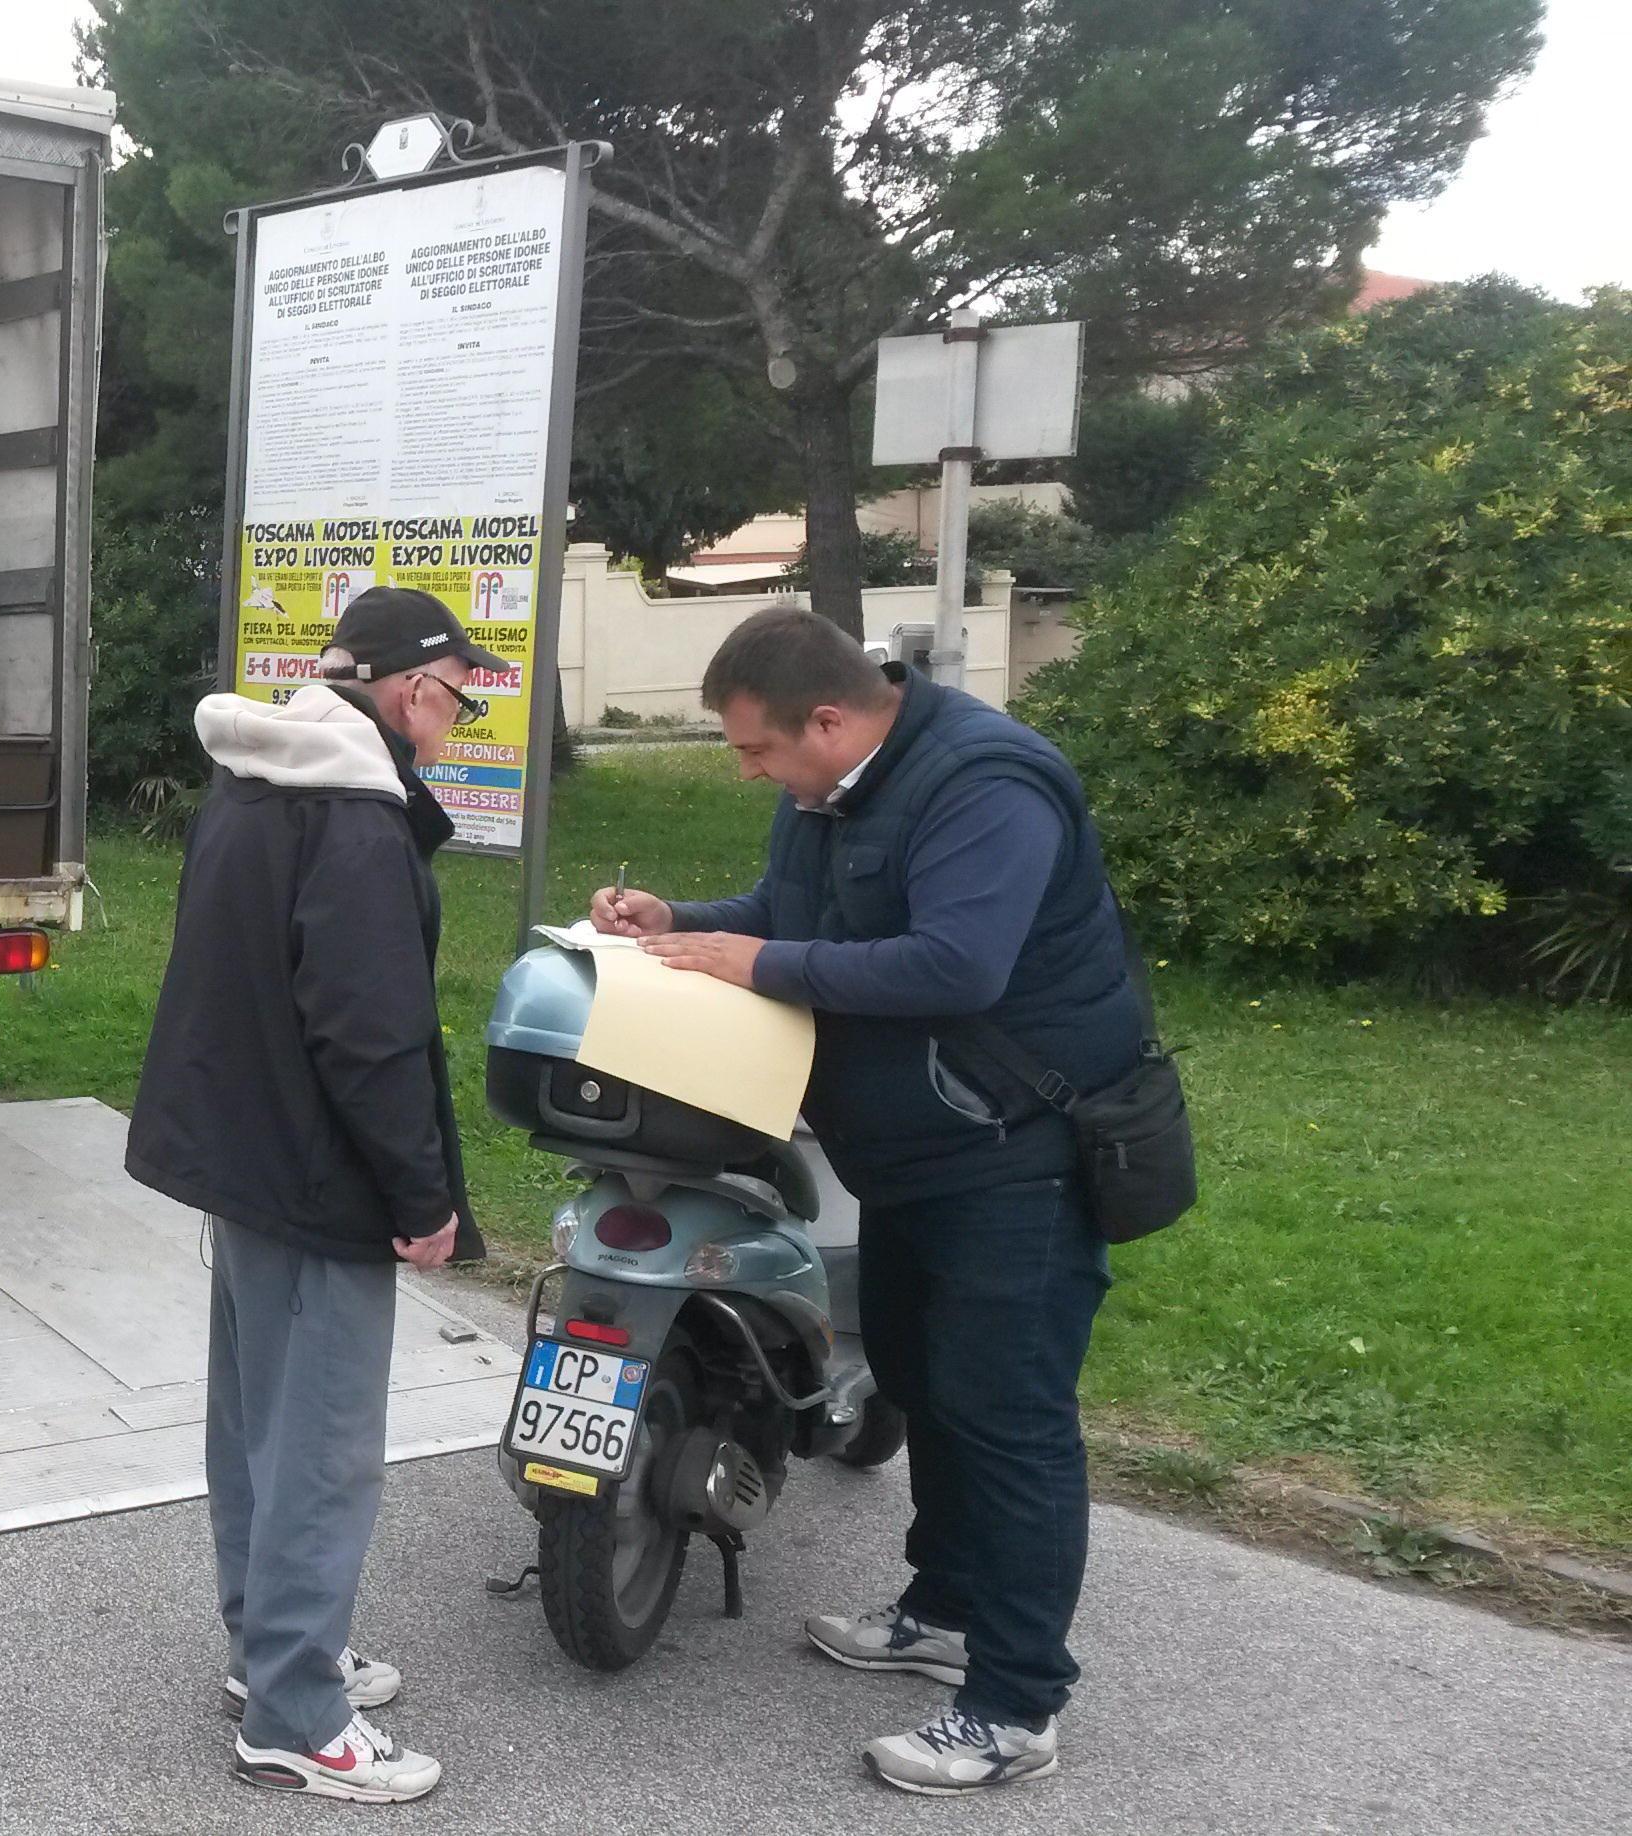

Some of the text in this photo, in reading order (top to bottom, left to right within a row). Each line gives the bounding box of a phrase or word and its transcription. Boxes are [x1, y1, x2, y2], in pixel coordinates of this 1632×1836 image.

[411, 237, 492, 259] AGGIORNAMENTO
[494, 227, 546, 247] DELL'ALBO
[268, 251, 386, 281] AGGIORNAMENTO DELL'ALBO
[405, 242, 551, 274] UNICO DELLE PERSONE IDONEE
[264, 264, 389, 295] UNICO DELLE PERSONE IDONEE
[411, 258, 543, 288] ALL'UFFICIO DI SCRUTATORE
[268, 279, 383, 307] ALL'UFFICIO DI SCRUTATORE
[420, 275, 530, 300] DI SEGGIO ELETTORALE
[277, 294, 372, 319] DI SEGGIO ELETTORALE
[460, 301, 492, 313] SINDACO
[245, 520, 379, 543] TOSCANA MODEL
[382, 515, 539, 541] TOSCANA MODEL
[254, 546, 375, 567] EXPO LIVORNO
[392, 543, 533, 566] EXPO LIVORNO
[243, 622, 272, 635] FIERA
[277, 623, 296, 636] DEL
[496, 644, 527, 653] VENDITA
[246, 657, 326, 679] 5-6 NOVE
[448, 726, 497, 740] ORANEA.
[440, 742, 515, 761] TTRONICA
[418, 765, 469, 782] TUNING
[434, 787, 519, 810] BENESSERE
[598, 1254, 638, 1266] PIAGGIO
[554, 1350, 599, 1394] CP
[518, 1400, 626, 1461] 97566
